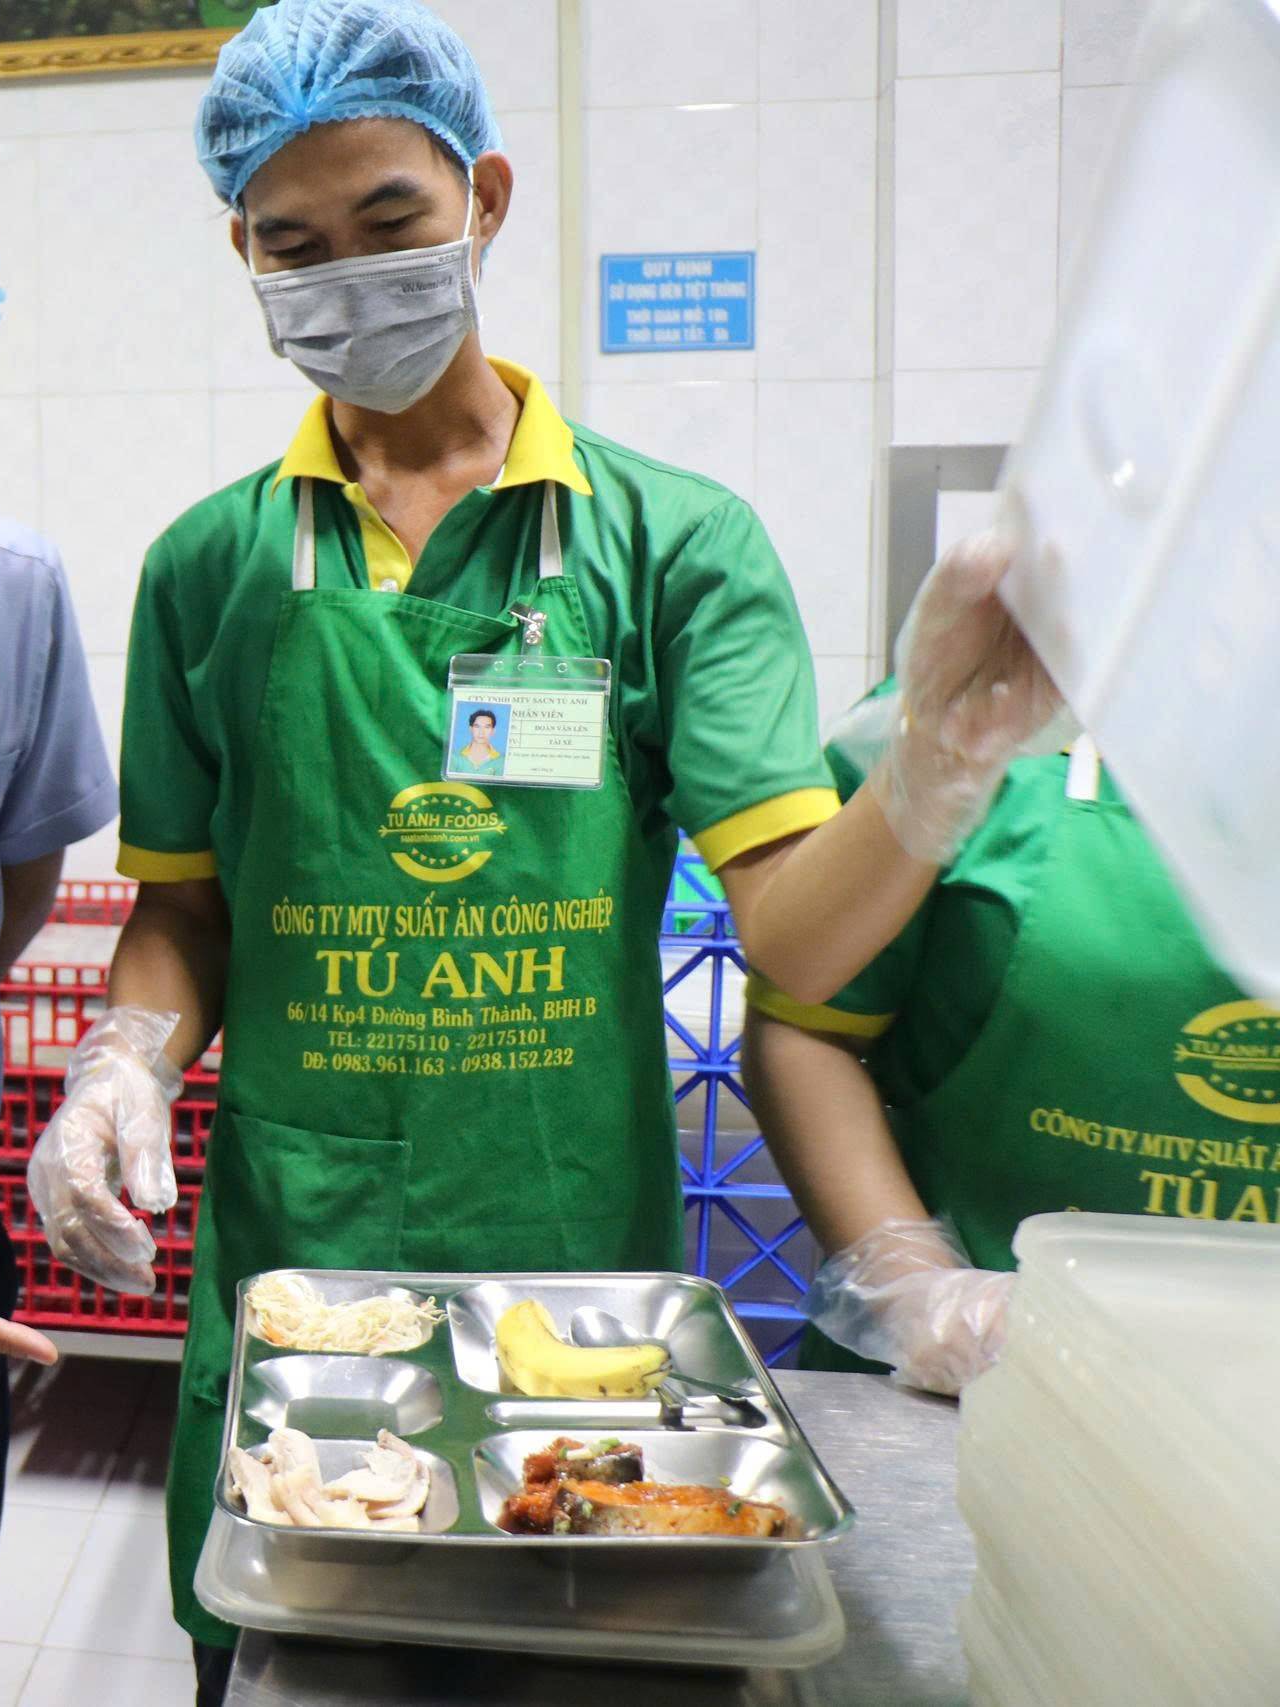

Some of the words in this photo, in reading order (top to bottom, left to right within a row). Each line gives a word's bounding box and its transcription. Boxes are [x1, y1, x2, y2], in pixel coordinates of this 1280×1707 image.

[642, 260, 672, 278] QUY
[407, 812, 440, 827] ANH
[444, 812, 499, 828] FOODS
[272, 895, 315, 935] CÔNG
[319, 904, 344, 936] TY
[345, 904, 391, 937] MTV
[394, 890, 449, 938] SUẤT
[453, 897, 486, 937] ĂN
[491, 894, 549, 937] CÔNG
[553, 887, 613, 935] NGHIỆP
[315, 936, 400, 998] TÚ
[420, 945, 567, 998] ANH
[287, 1002, 328, 1024] 66/14
[332, 1003, 366, 1027] Kp4
[371, 1005, 426, 1031] Đường
[432, 1007, 474, 1027] Bình
[543, 998, 581, 1020] BHH
[585, 996, 597, 1016] B
[328, 1030, 362, 1048] TEL:
[367, 1032, 450, 1052] 22175110
[467, 1028, 547, 1050] 22175101
[302, 1051, 328, 1070] DĐ:
[332, 1053, 445, 1076] 0983.961.163
[461, 1047, 574, 1073] 0938.152.232
[1030, 1106, 1103, 1147] CÔNG
[1104, 1125, 1139, 1154] TY
[1137, 1132, 1197, 1162] MTV
[1139, 1168, 1219, 1221] TÚ
